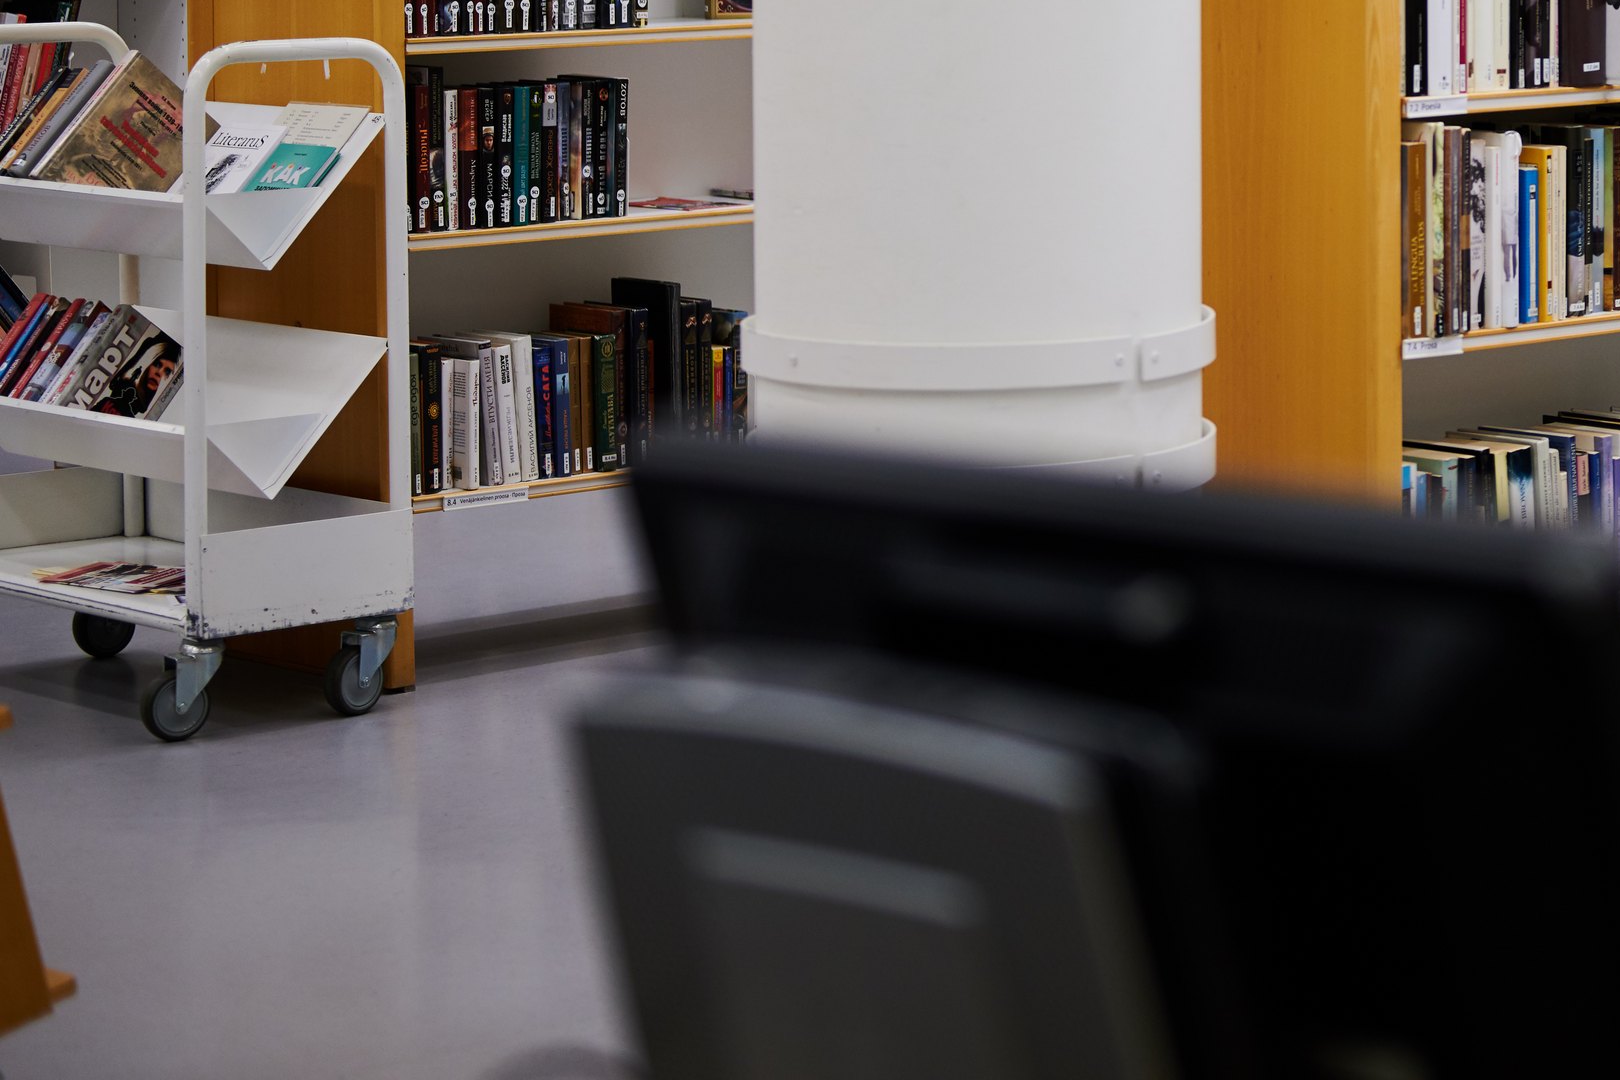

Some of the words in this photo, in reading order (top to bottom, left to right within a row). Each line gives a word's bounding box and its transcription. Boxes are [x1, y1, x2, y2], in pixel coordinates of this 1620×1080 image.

[1421, 101, 1441, 111] Poesia
[260, 165, 311, 186] КАК
[1421, 341, 1438, 350] Prosa
